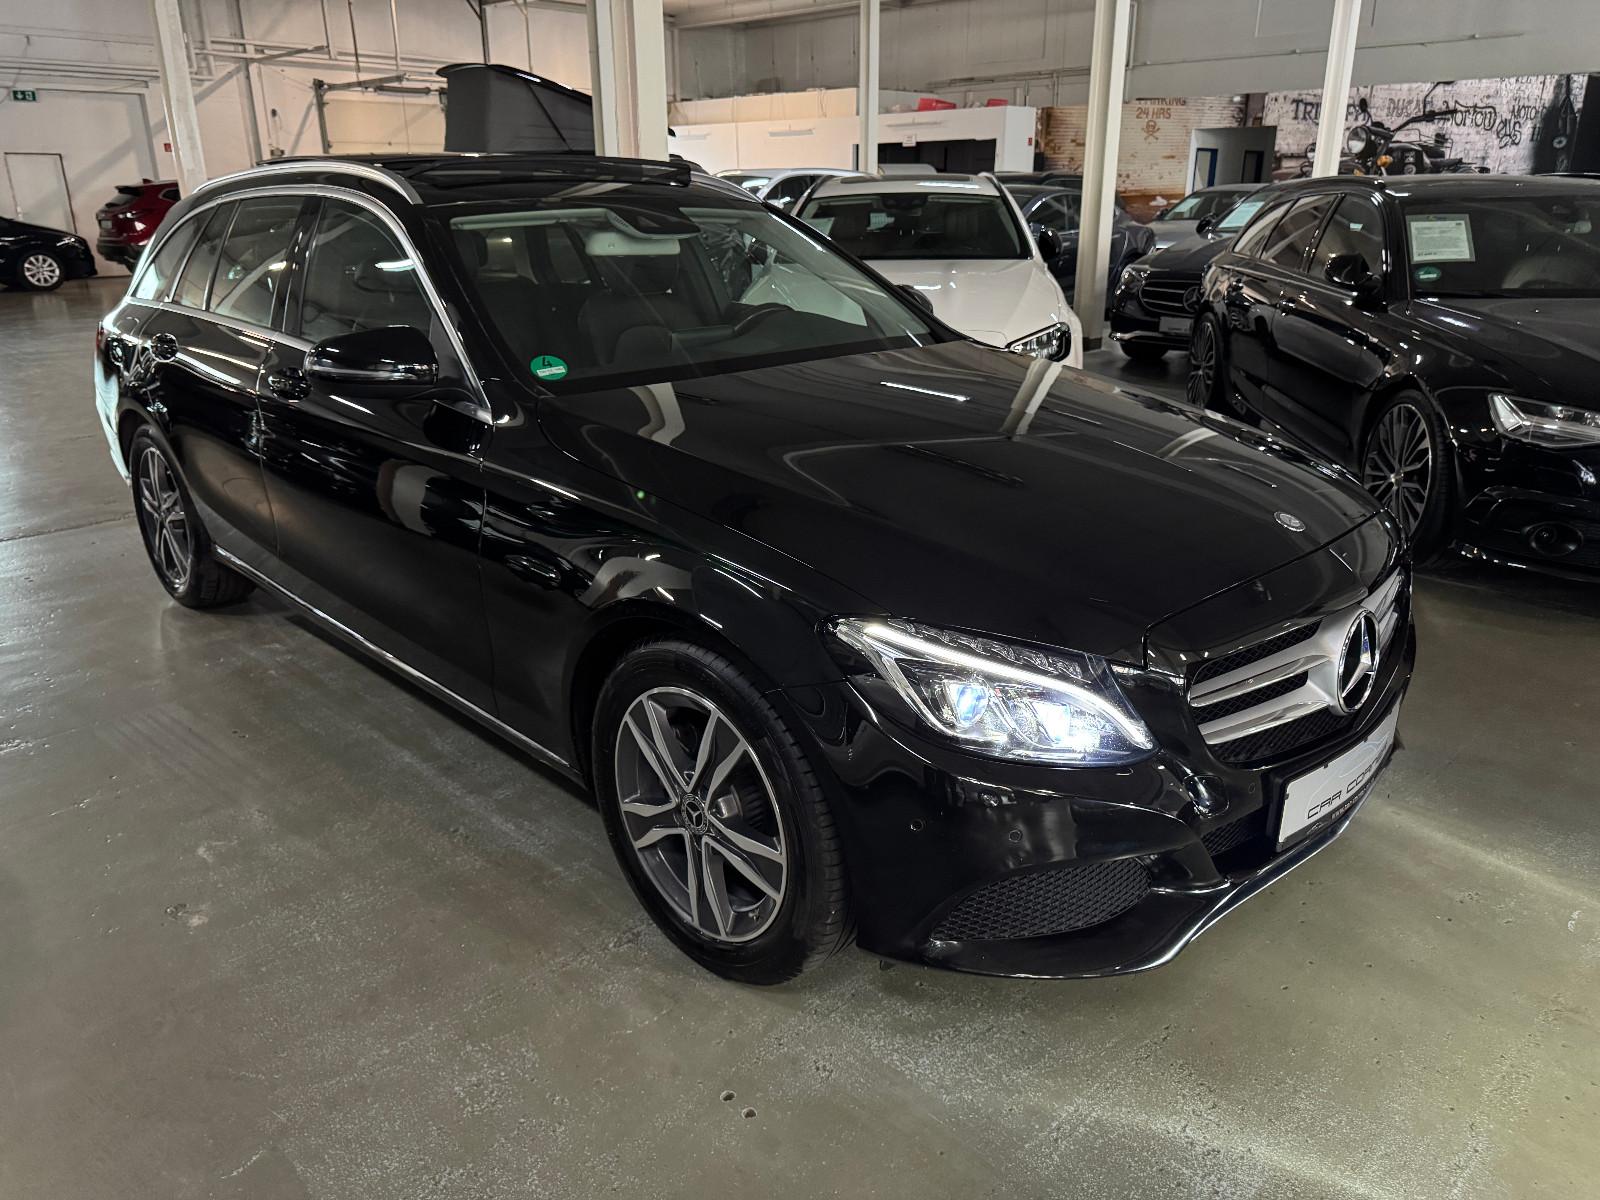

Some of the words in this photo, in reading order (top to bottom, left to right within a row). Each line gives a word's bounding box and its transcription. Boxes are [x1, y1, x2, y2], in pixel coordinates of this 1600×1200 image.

[1135, 107, 1149, 119] 24
[1151, 107, 1172, 119] HRS
[1307, 790, 1343, 819] CAR
[1346, 740, 1388, 794] CORN
